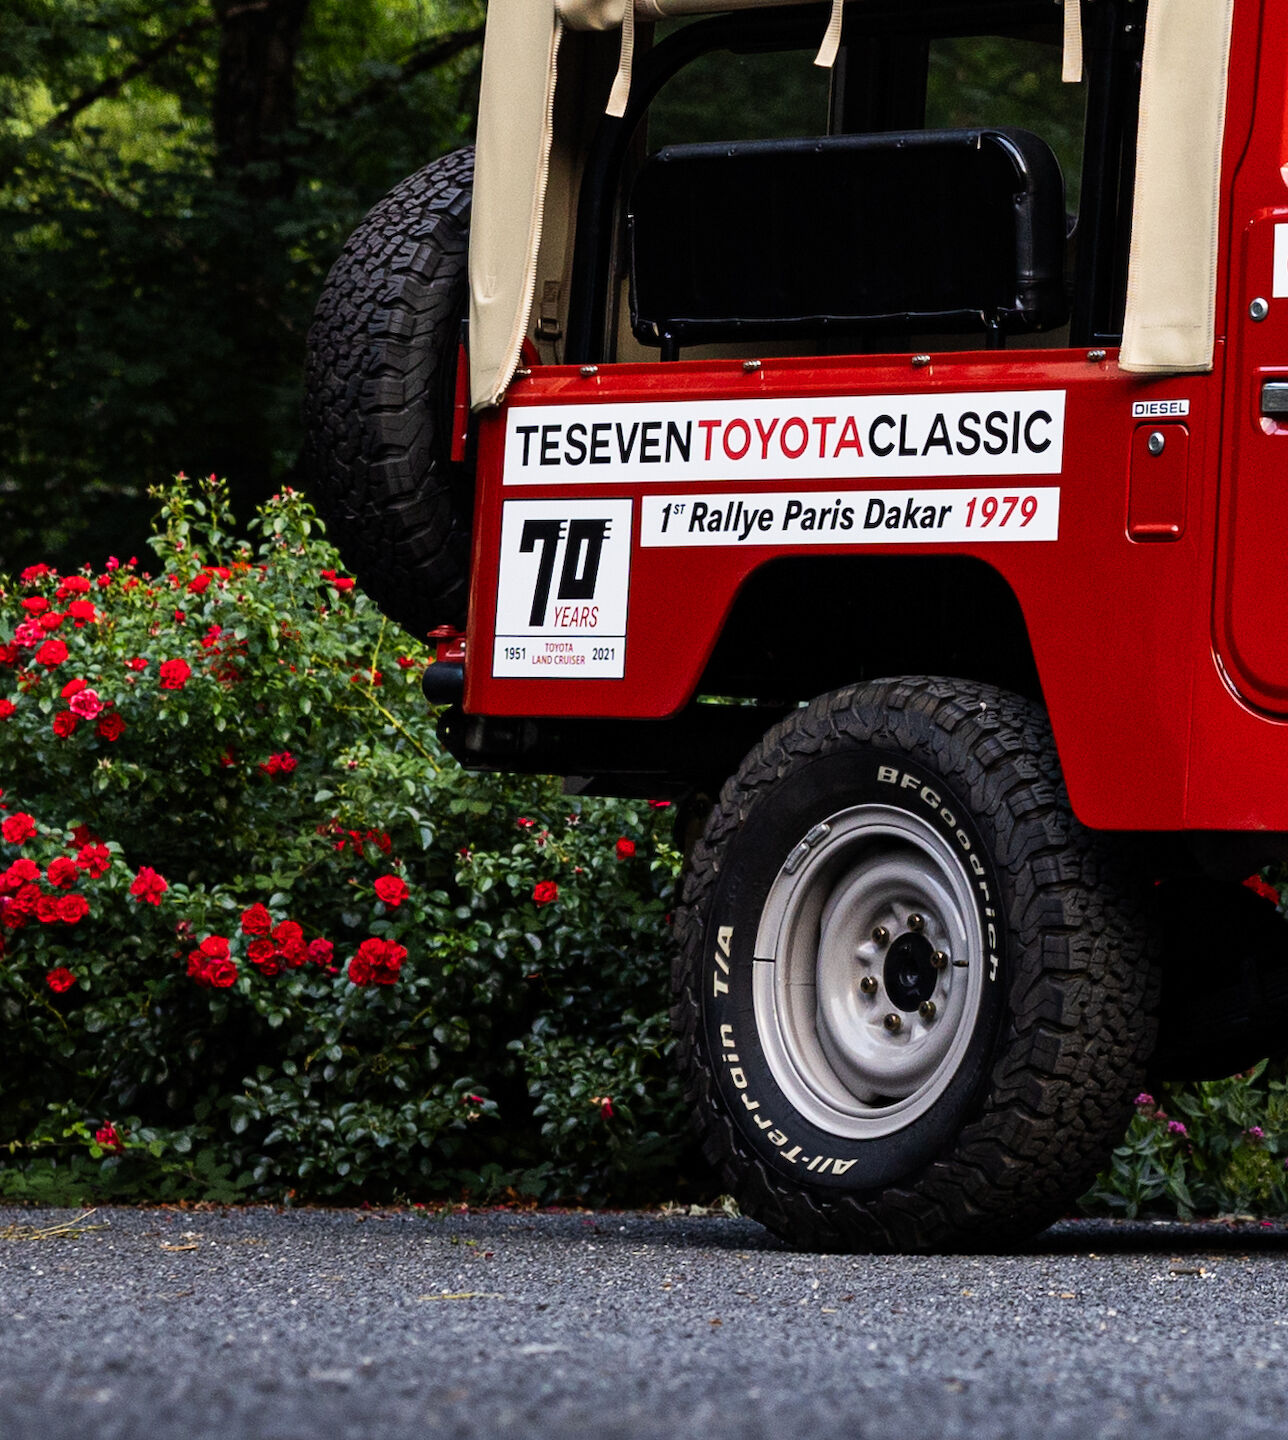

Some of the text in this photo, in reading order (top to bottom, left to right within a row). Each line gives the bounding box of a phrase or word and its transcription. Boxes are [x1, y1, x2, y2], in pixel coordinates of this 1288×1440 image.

[1134, 402, 1186, 415] DIESEL
[688, 500, 774, 541] Rallye
[782, 498, 855, 531] Paris
[863, 497, 953, 529] Dakar
[964, 495, 1039, 528] 1979
[553, 605, 600, 628] YEARS
[504, 647, 526, 660] 1951
[545, 643, 574, 652] TOYOTA
[592, 647, 615, 660] 2021
[532, 655, 585, 665] LAND CRUISER
[713, 925, 735, 999] T/A
